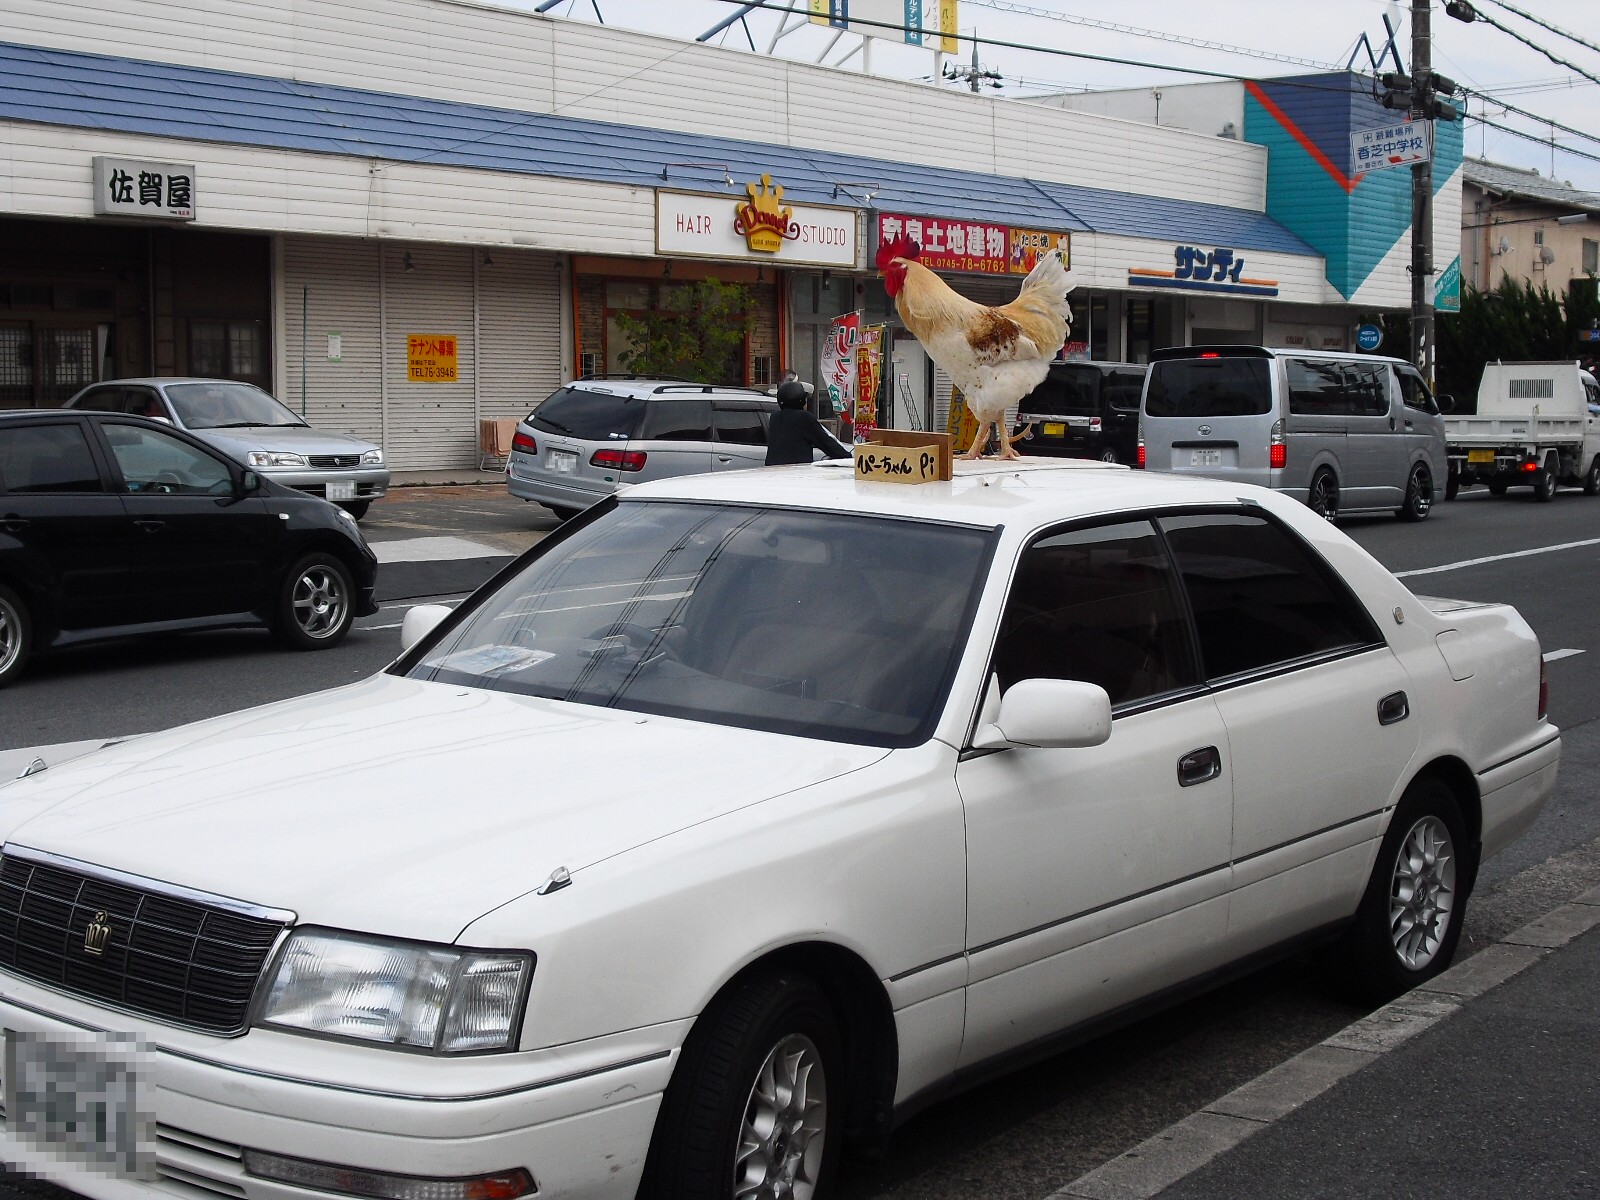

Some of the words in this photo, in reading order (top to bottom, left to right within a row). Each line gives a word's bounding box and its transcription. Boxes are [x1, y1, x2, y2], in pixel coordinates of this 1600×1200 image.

[1376, 126, 1413, 140] 避難場所
[1358, 136, 1423, 160] 香芝中学校
[109, 168, 190, 208] 佐賀屋
[676, 213, 711, 234] HAIR
[803, 225, 846, 246] STUDIO
[882, 217, 1005, 258] 奈良土地建物
[1021, 232, 1049, 248] たこ焼
[1175, 246, 1244, 283] サンディ
[410, 339, 453, 356] テナント募集
[857, 454, 912, 475] ぴーちゃん
[920, 452, 935, 479] Pi
